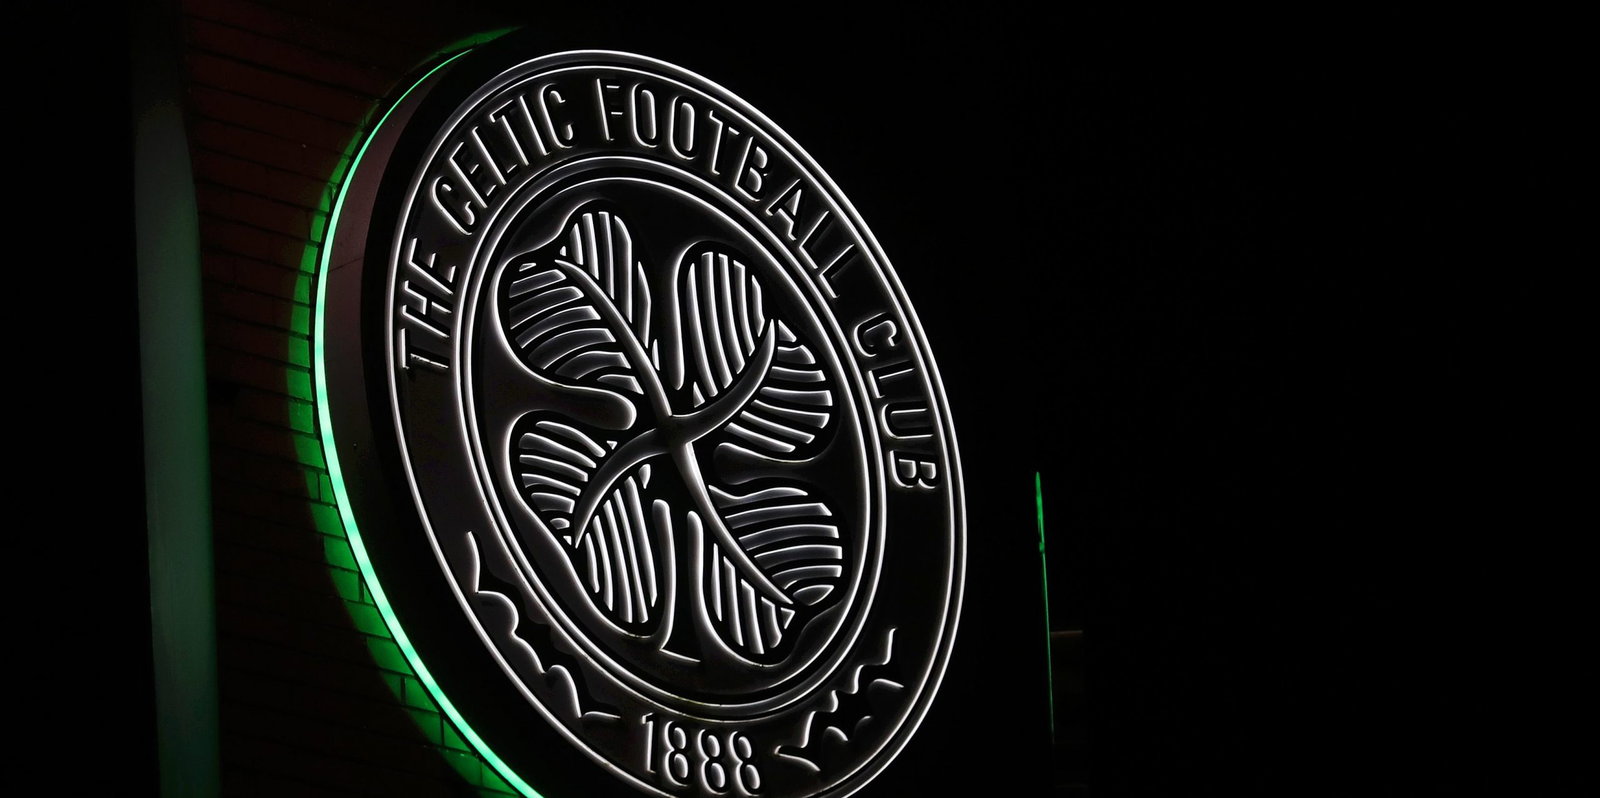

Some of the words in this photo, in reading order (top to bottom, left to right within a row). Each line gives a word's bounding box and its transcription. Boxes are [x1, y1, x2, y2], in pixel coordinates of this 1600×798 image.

[399, 238, 458, 370] THE
[431, 83, 577, 236] CELTIC
[594, 77, 858, 299] FOOTBALL
[853, 311, 941, 489] CLUB
[641, 712, 765, 796] 1888
